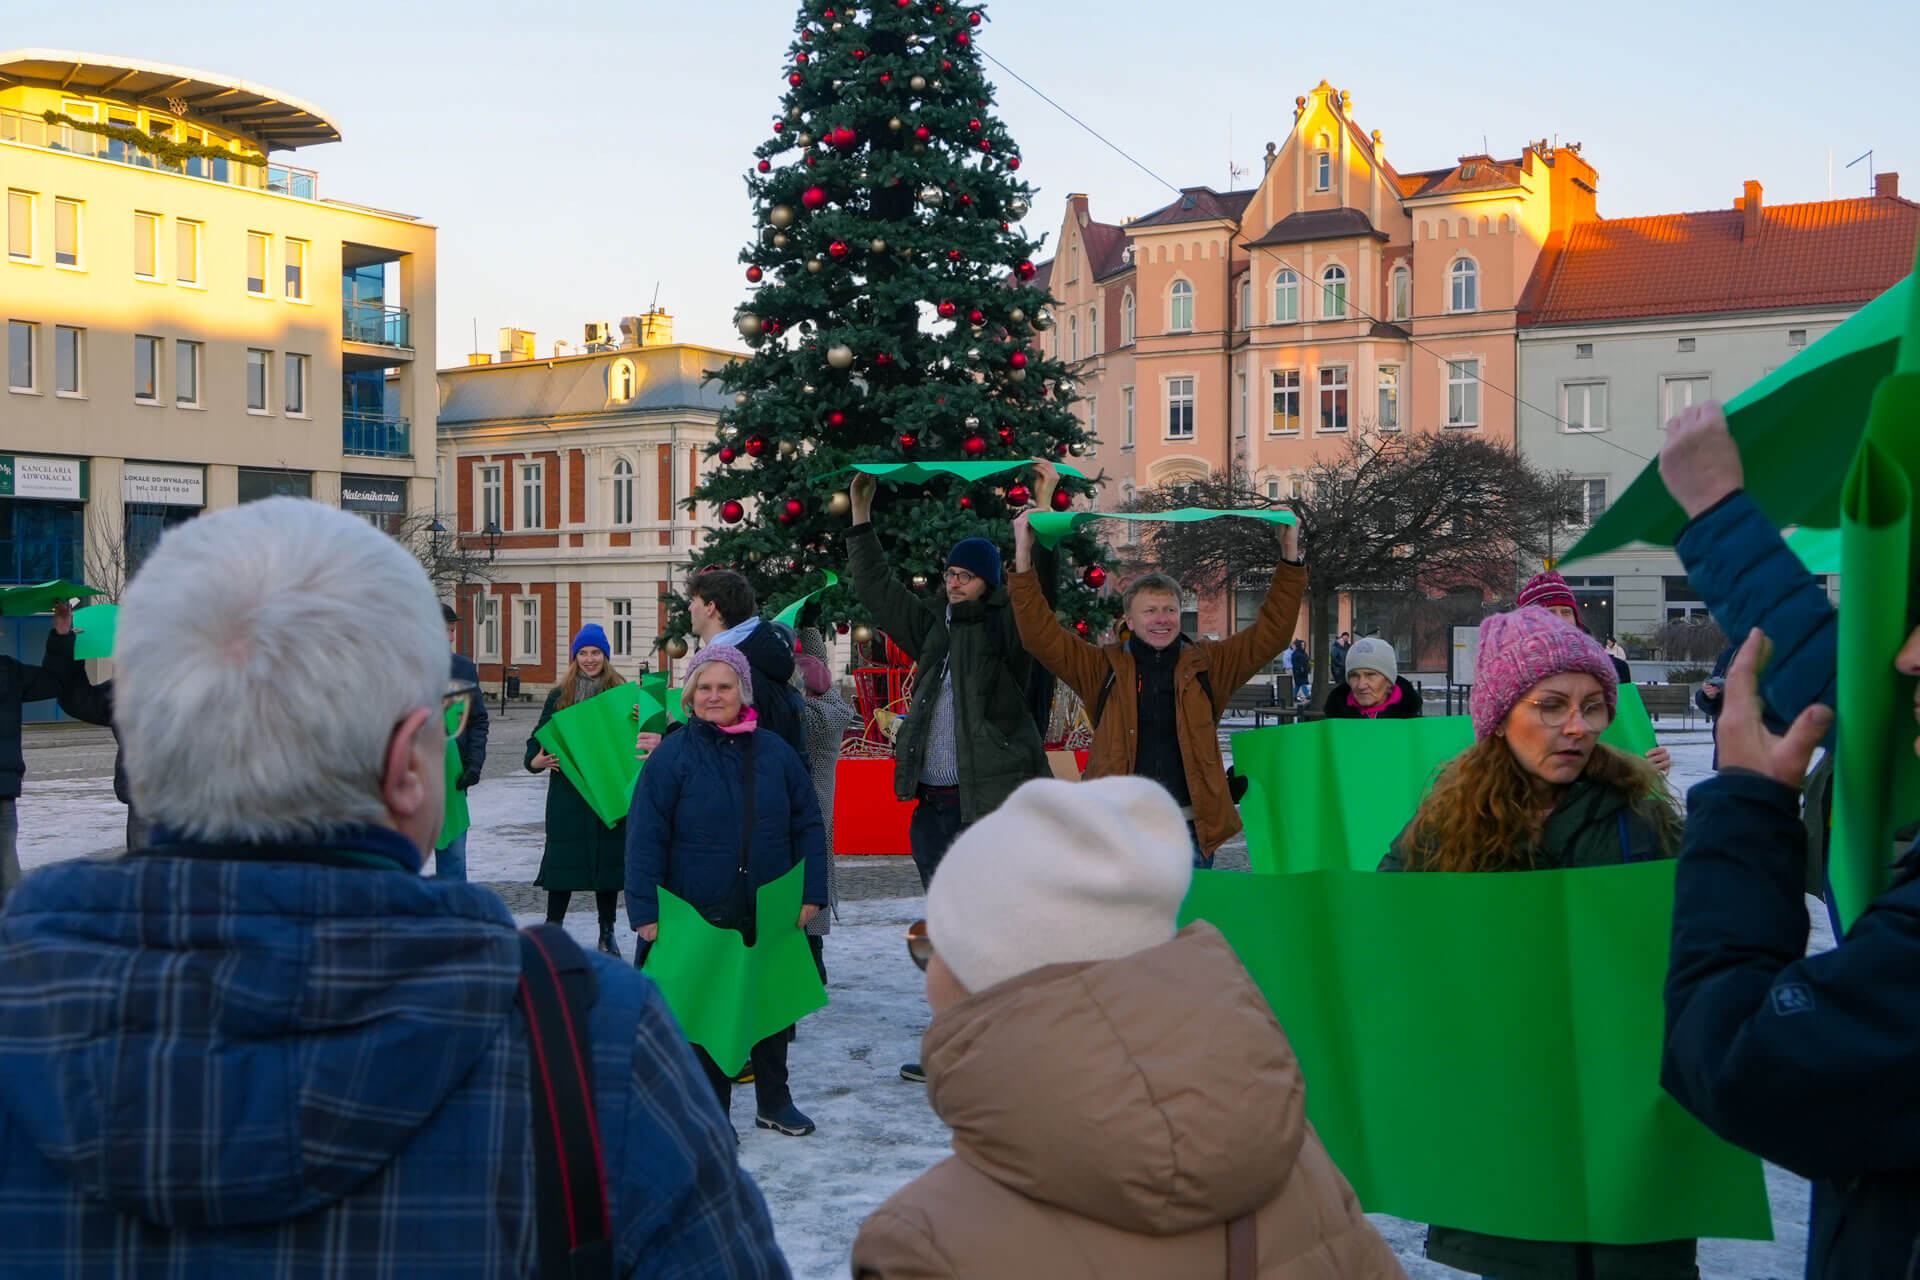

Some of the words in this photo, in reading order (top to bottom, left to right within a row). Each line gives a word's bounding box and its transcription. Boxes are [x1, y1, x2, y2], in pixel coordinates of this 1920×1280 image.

[21, 464, 72, 473] KANCELARIA
[21, 473, 72, 481] ADWOKACKA
[163, 477, 200, 485] WYNAJĘCIA
[342, 489, 399, 501] Naleśnikarnia
